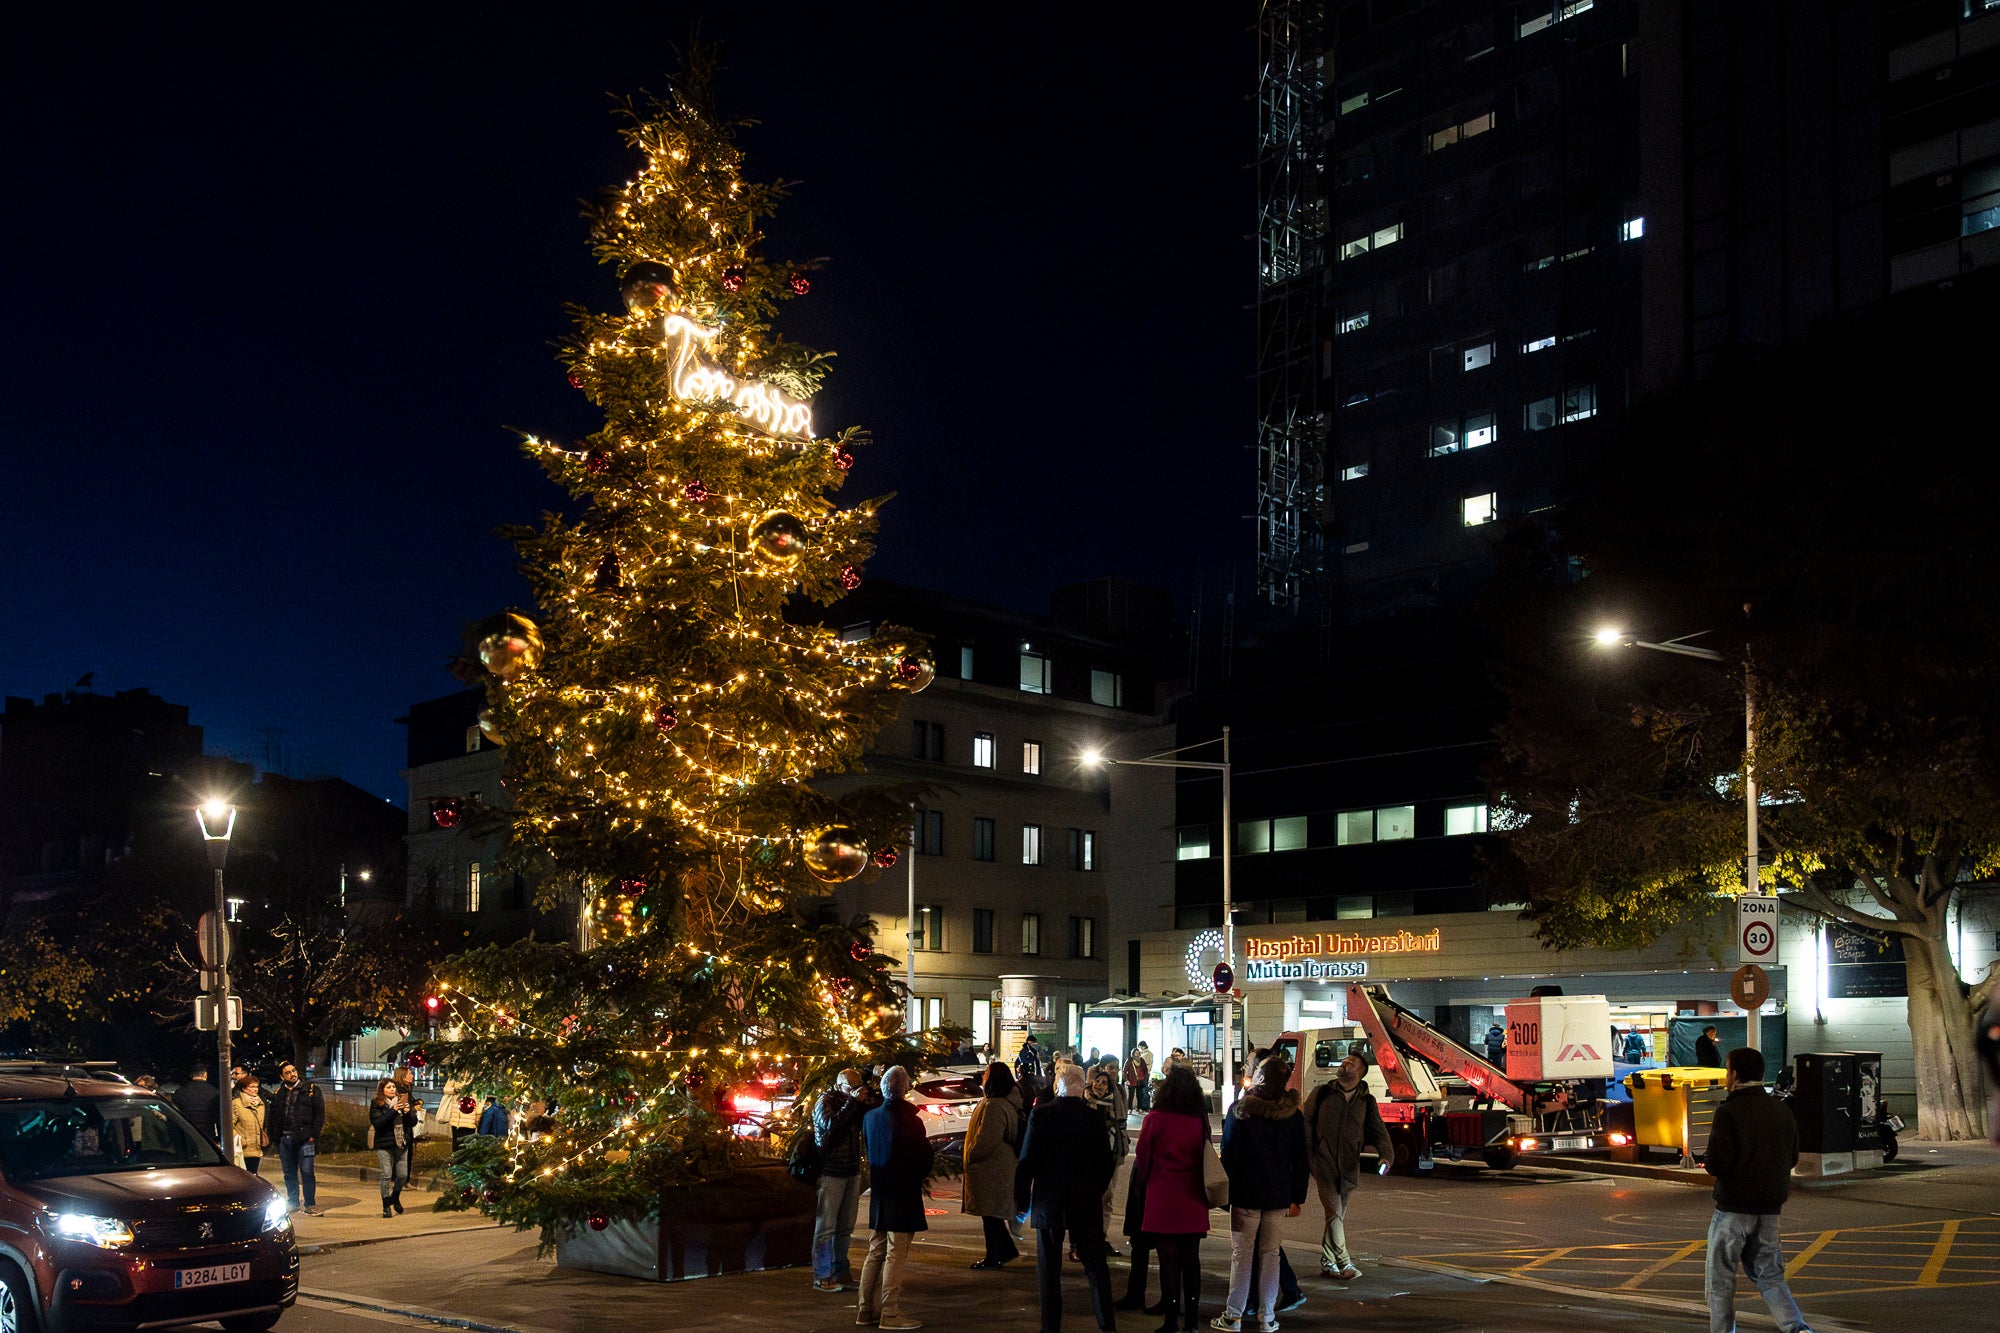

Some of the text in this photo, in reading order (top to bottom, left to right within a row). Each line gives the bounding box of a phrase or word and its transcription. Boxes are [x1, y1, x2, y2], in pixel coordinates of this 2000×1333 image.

[1742, 903, 1775, 914] ZONA
[1246, 927, 1441, 962] Hospital Universitari
[1750, 933, 1767, 944] 30
[1246, 958, 1368, 981] MútuaTerrassa
[185, 1264, 246, 1285] 3284 LGY
